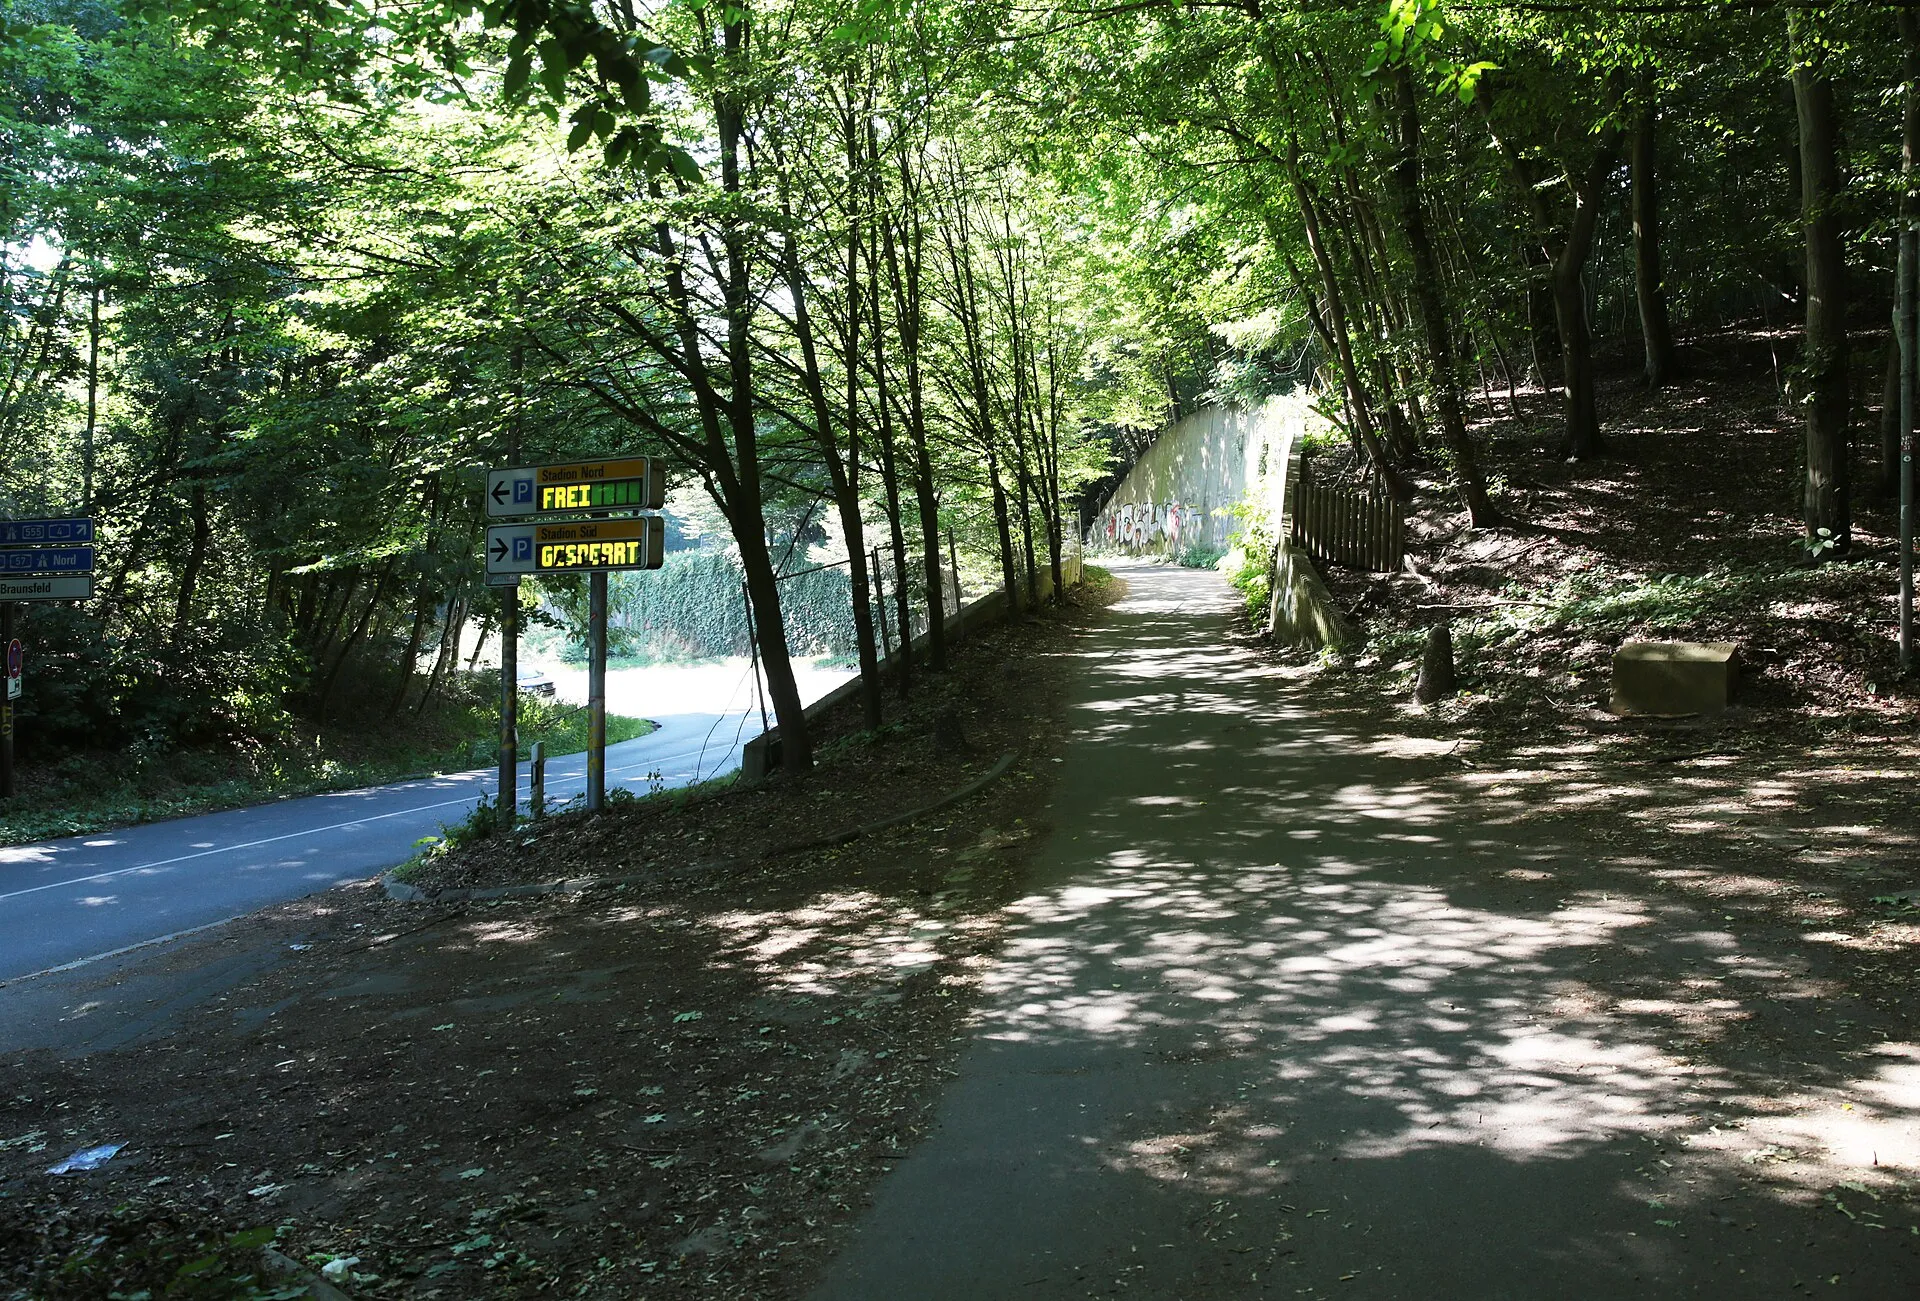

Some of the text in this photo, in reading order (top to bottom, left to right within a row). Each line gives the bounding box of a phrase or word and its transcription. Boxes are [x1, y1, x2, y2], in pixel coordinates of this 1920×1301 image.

[542, 466, 604, 481] Stadion Nord
[517, 482, 528, 500] P
[542, 484, 591, 510] FREI
[25, 527, 63, 537] 555 4
[541, 525, 597, 541] Stadion Süd
[517, 540, 528, 558] P
[15, 554, 76, 566] 57 Nord
[0, 582, 51, 595] Braunsfeld
